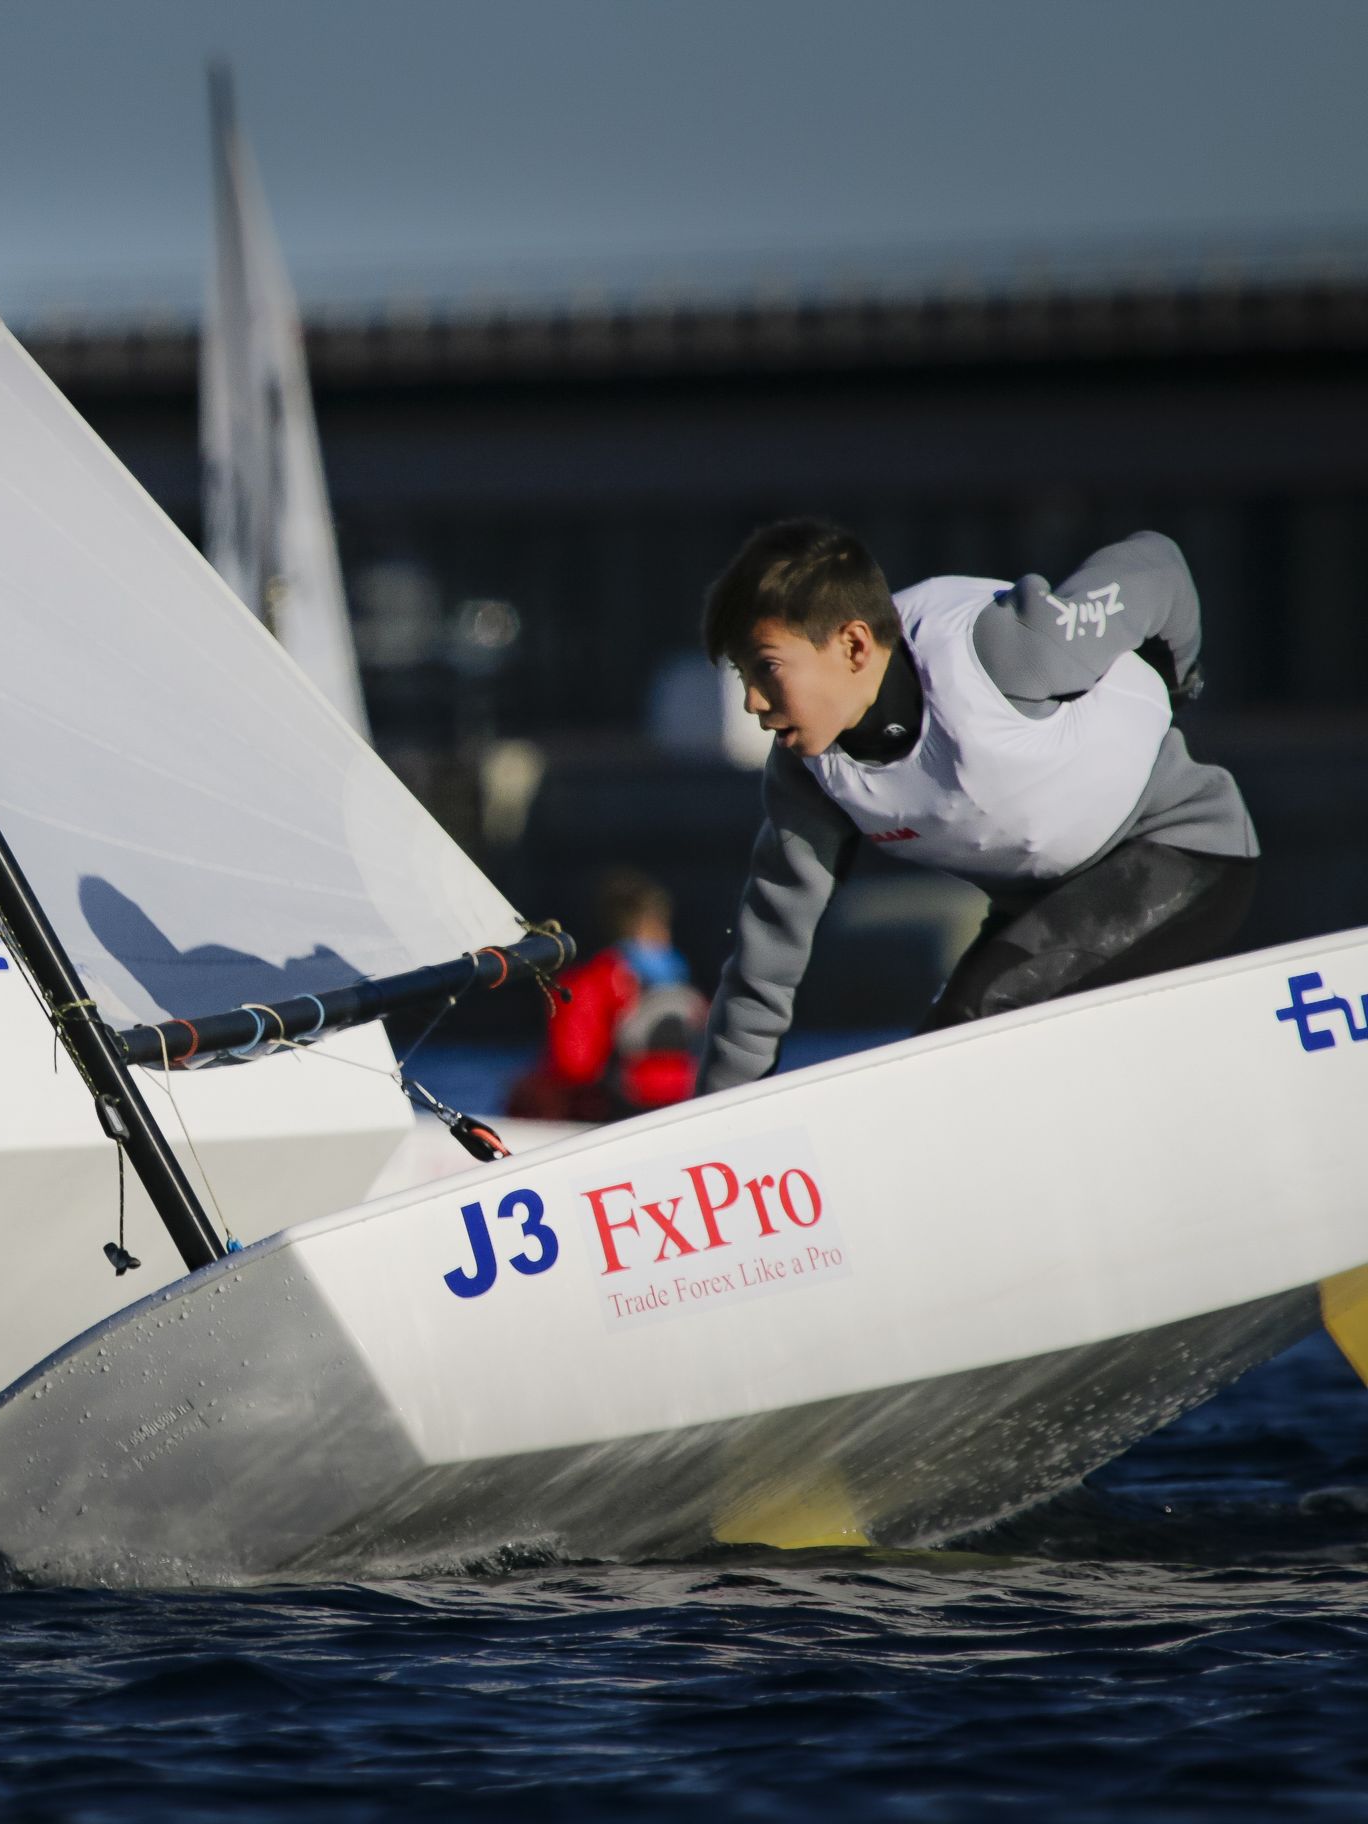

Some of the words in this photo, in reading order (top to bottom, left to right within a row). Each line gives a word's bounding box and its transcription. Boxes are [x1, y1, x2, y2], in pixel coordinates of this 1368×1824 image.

[443, 1188, 560, 1298] J3
[580, 1161, 823, 1276] FxPro
[608, 1284, 670, 1319] Trade
[673, 1276, 736, 1303] Forex
[738, 1258, 787, 1288] Like
[791, 1257, 805, 1275] a
[806, 1246, 843, 1271] Pro
